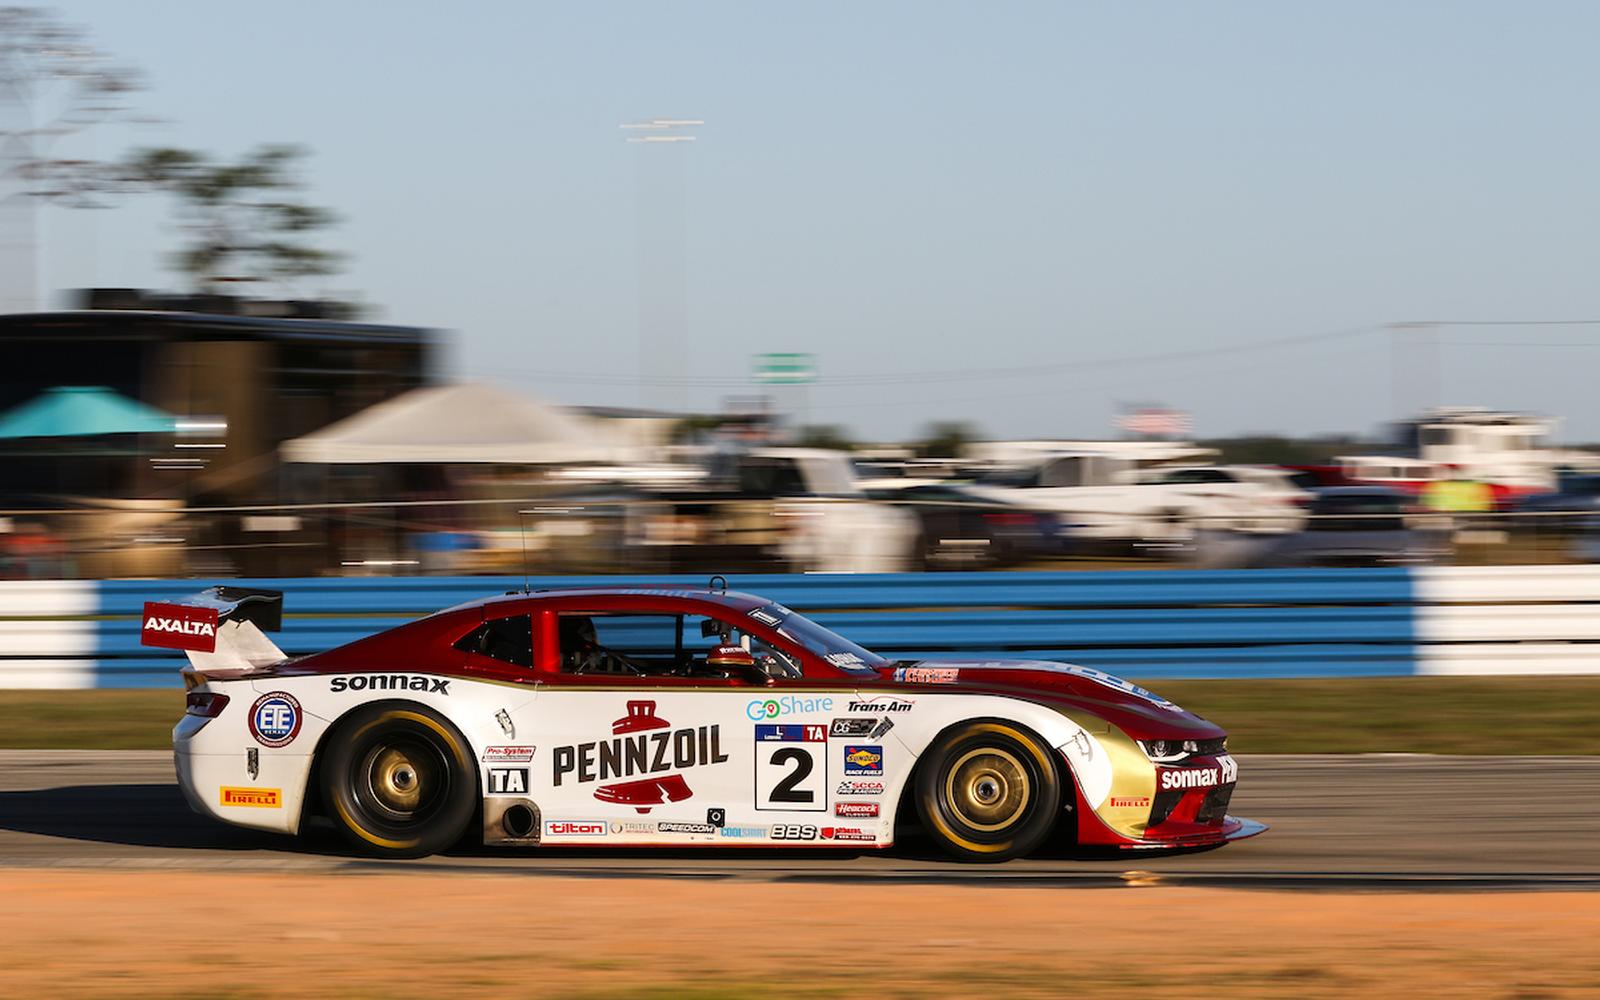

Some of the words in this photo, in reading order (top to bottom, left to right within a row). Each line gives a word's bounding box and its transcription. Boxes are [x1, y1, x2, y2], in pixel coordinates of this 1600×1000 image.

[144, 617, 215, 637] AXALTA
[330, 675, 450, 696] sonnax
[848, 701, 886, 712] Trans
[887, 701, 912, 712] Am
[260, 704, 291, 730] ETE
[807, 726, 824, 740] TA
[553, 724, 729, 787] PENNZOIL
[848, 754, 880, 763] SUNOCO
[492, 770, 525, 792] TA
[768, 747, 814, 803] 2
[1162, 768, 1218, 789] sonnax
[225, 790, 276, 804] PIRELLI
[1110, 797, 1149, 807] PIRELLI
[839, 804, 877, 813] Heacock
[549, 823, 603, 834] tilton
[658, 823, 714, 833] SPEEDCOM
[770, 823, 817, 840] BBS
